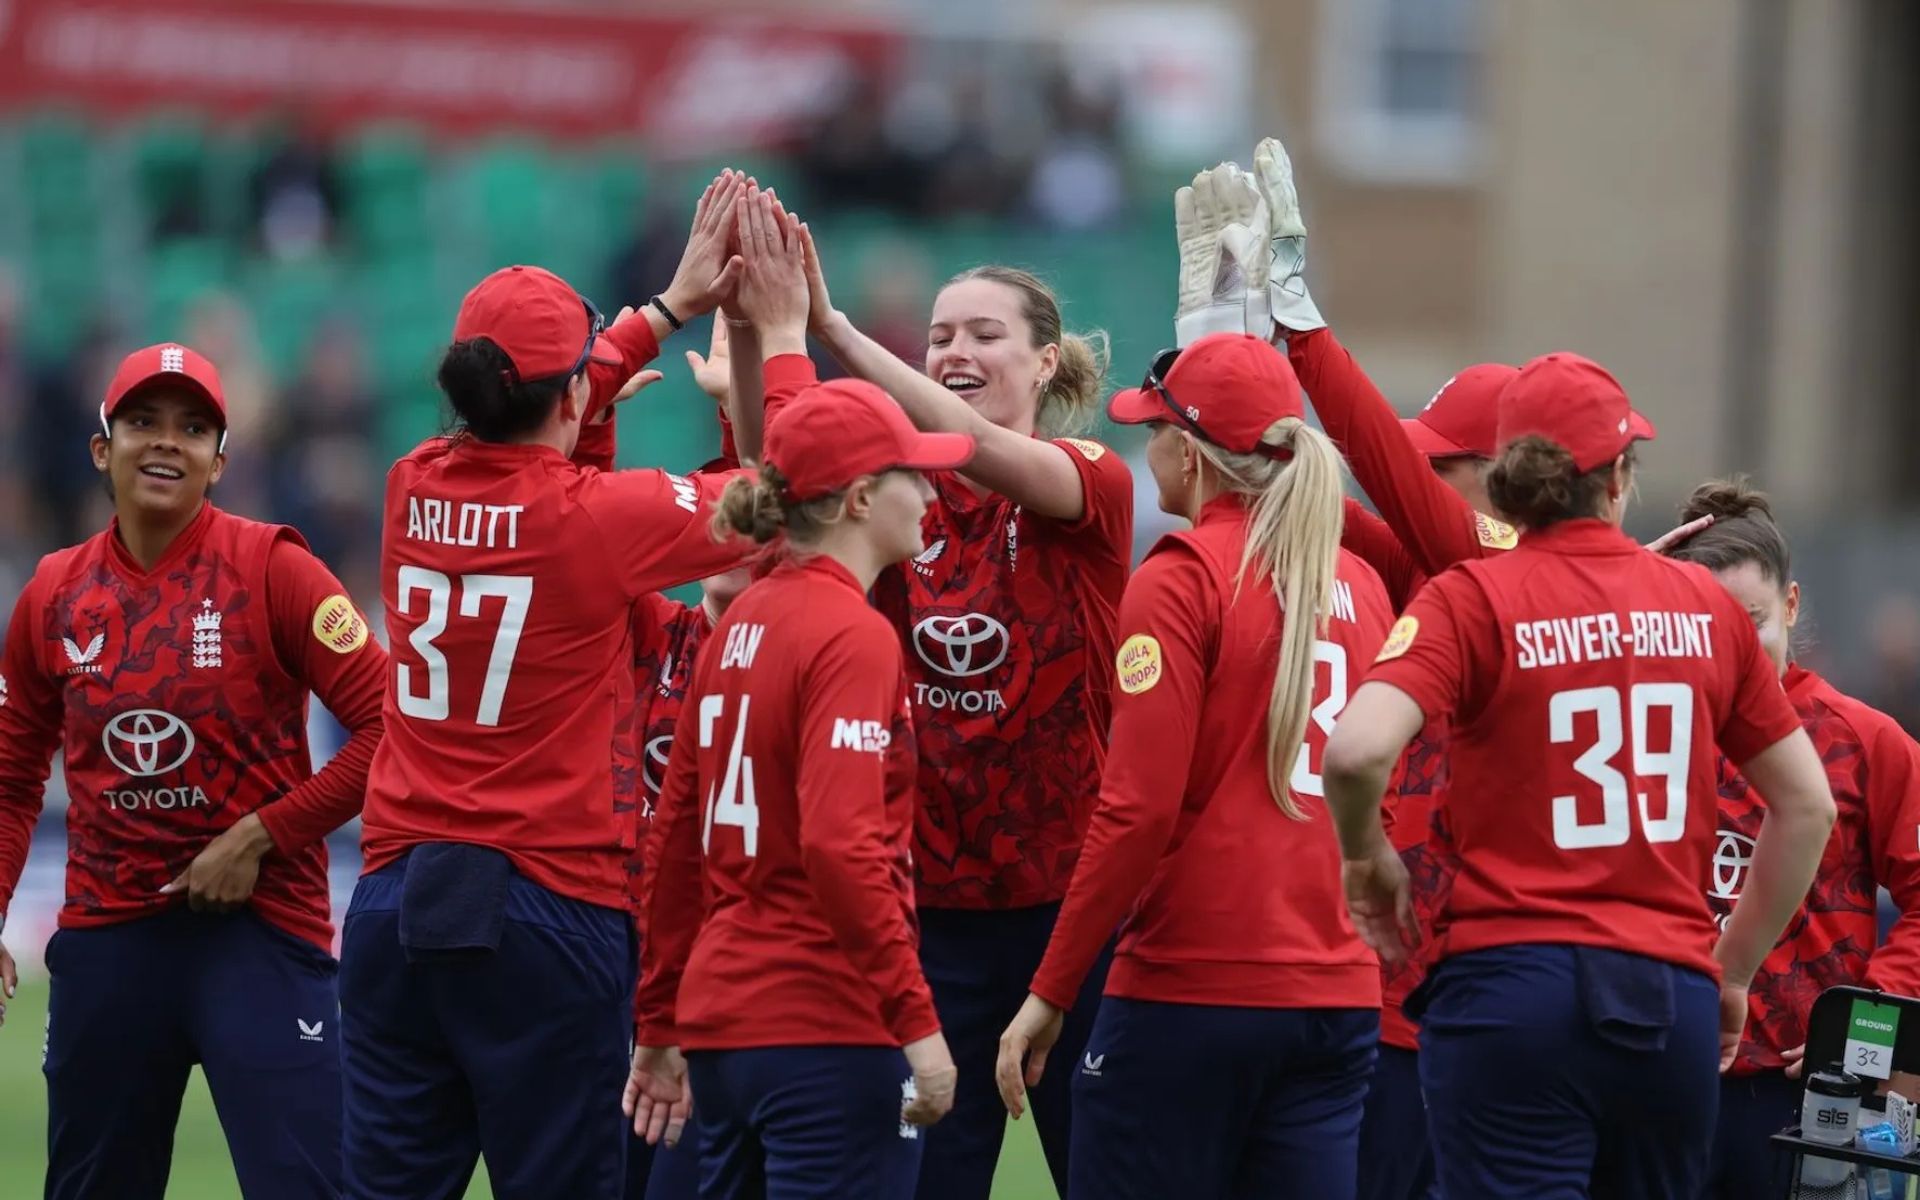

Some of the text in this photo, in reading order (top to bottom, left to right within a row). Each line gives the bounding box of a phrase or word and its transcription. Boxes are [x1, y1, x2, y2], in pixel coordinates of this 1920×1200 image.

[1186, 405, 1200, 421] 50
[407, 497, 524, 548] ARLOTT
[322, 603, 348, 634] HULA
[332, 614, 361, 648] HOOPS
[397, 564, 534, 727] 37
[1515, 611, 1714, 669] SCIVER-BRUNT
[1124, 644, 1151, 669] HULA
[1124, 660, 1157, 687] HOOPS
[914, 682, 1008, 713] TOYOTA
[1549, 683, 1694, 849] 39
[103, 785, 211, 810] TOYOTA
[1855, 1018, 1894, 1032] GROUND
[1856, 1047, 1881, 1067] 32
